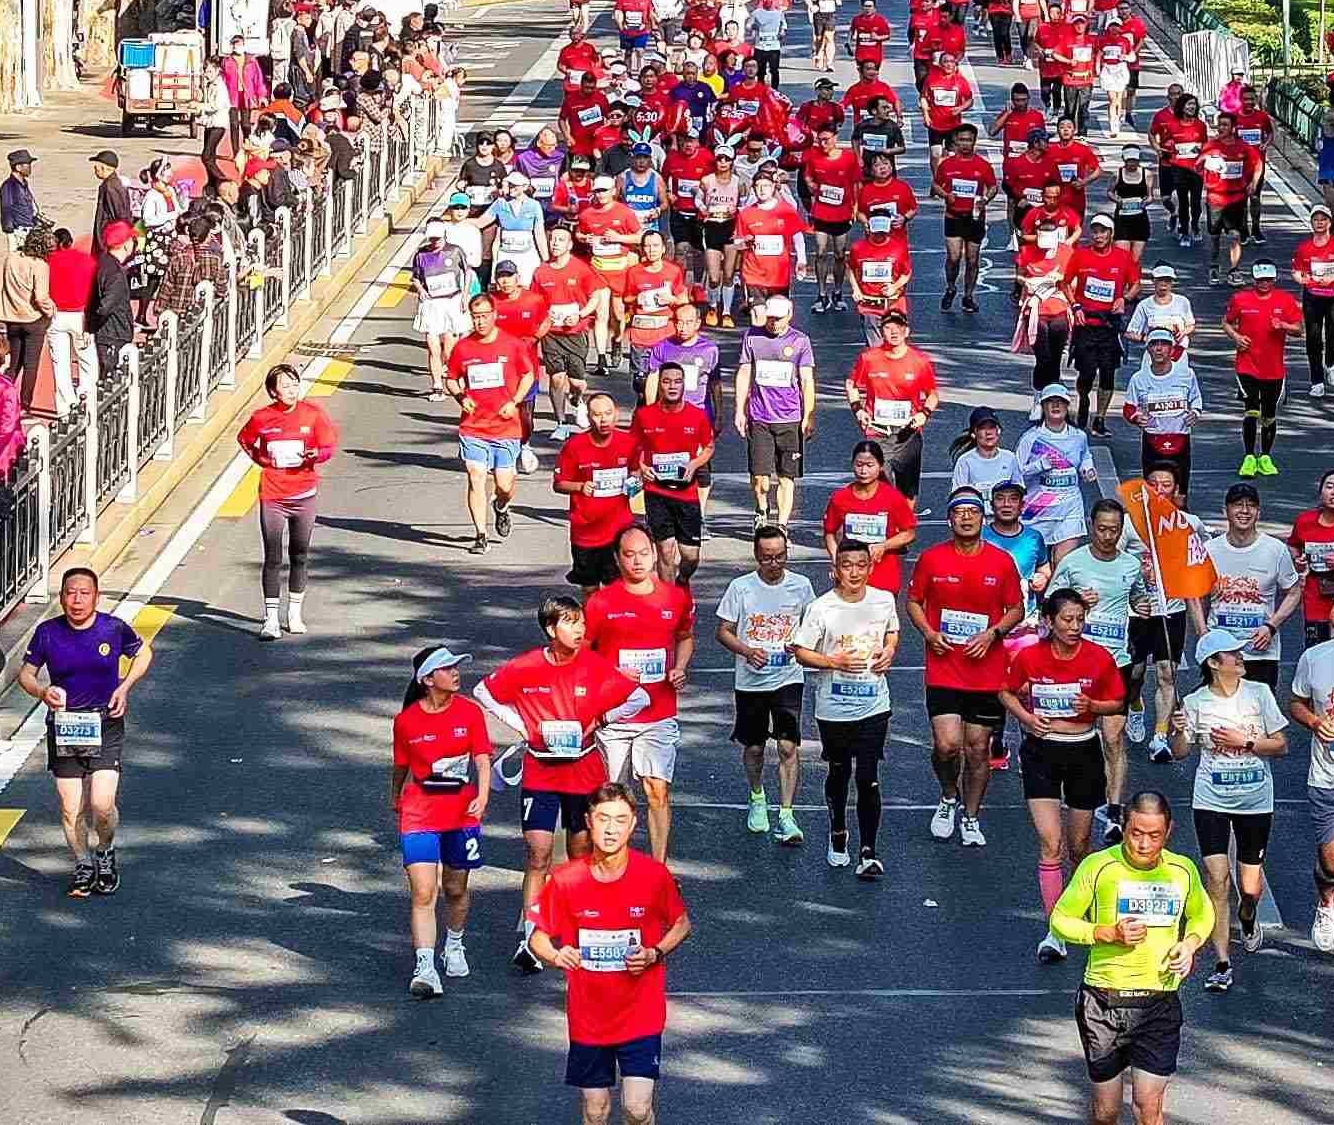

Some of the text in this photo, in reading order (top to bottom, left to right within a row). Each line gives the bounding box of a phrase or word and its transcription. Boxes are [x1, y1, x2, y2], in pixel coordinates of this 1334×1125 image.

[626, 194, 654, 203] PACER
[523, 797, 534, 822] 7
[465, 837, 480, 861] 2
